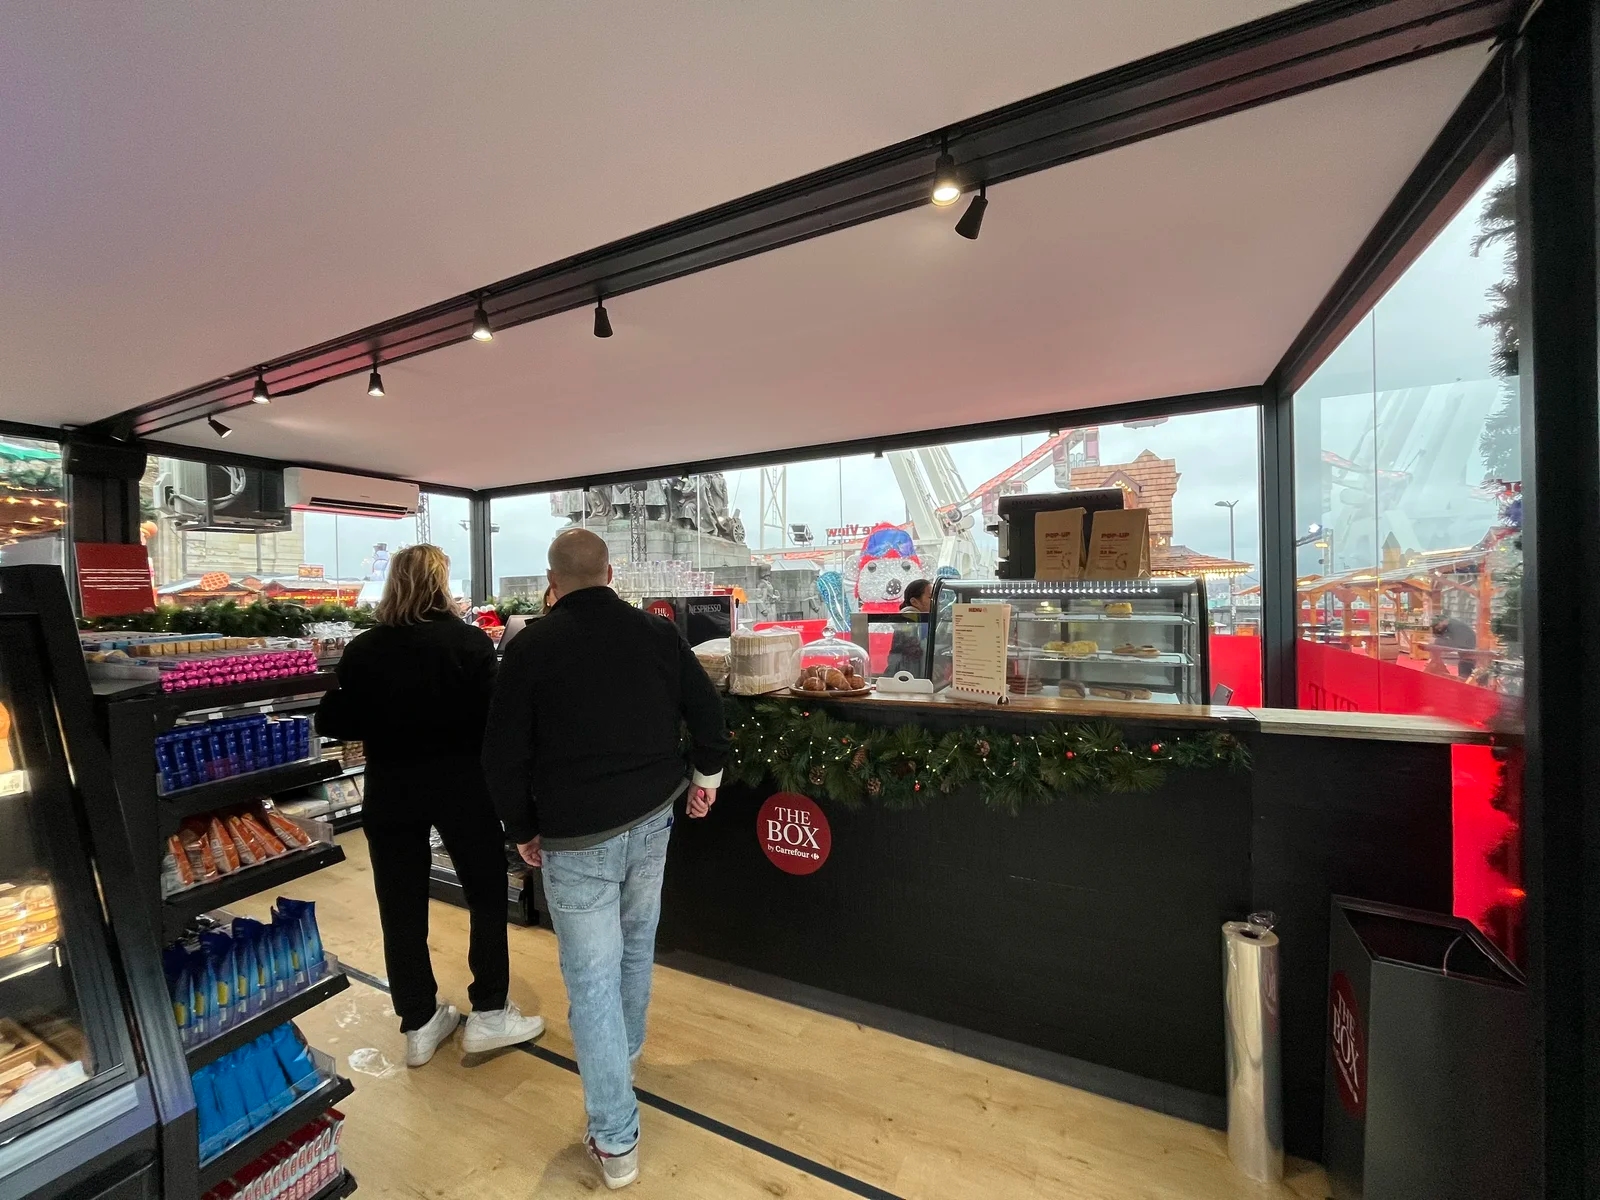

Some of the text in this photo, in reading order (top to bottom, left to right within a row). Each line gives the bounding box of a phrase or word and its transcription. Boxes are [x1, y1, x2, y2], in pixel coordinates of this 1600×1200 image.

[688, 604, 722, 615] NESPRESSO
[774, 807, 810, 825] THE
[767, 820, 820, 849] BOX
[767, 843, 809, 858] by Carrefour
[1337, 990, 1356, 1042] THE
[1333, 1003, 1360, 1090] BOX
